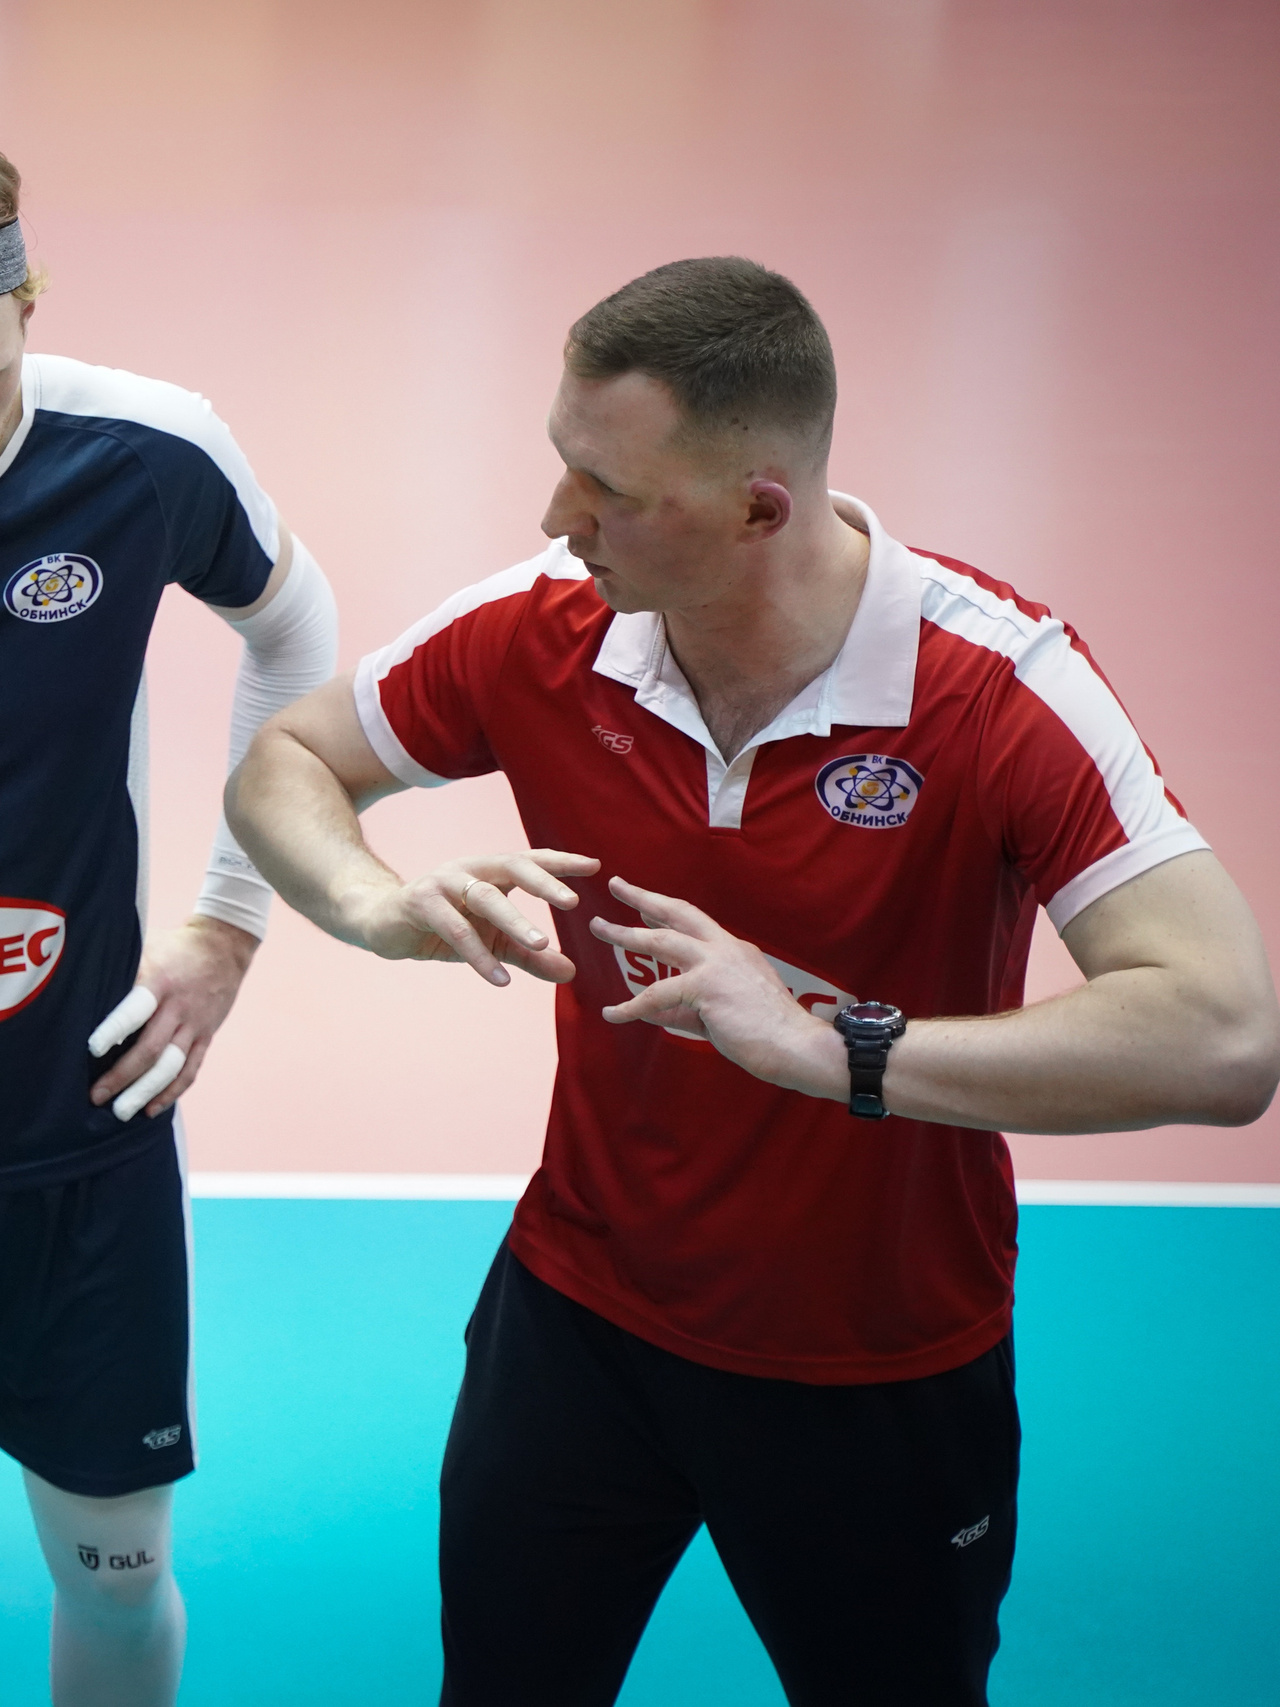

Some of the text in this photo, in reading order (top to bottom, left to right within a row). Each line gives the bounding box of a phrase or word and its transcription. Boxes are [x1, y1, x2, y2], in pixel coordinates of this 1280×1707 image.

[46, 555, 61, 564] ВК
[20, 599, 86, 620] ОБНИНСК
[871, 755, 884, 764] ВК
[831, 806, 907, 827] ОБНИНСК
[109, 1551, 155, 1570] GUL
